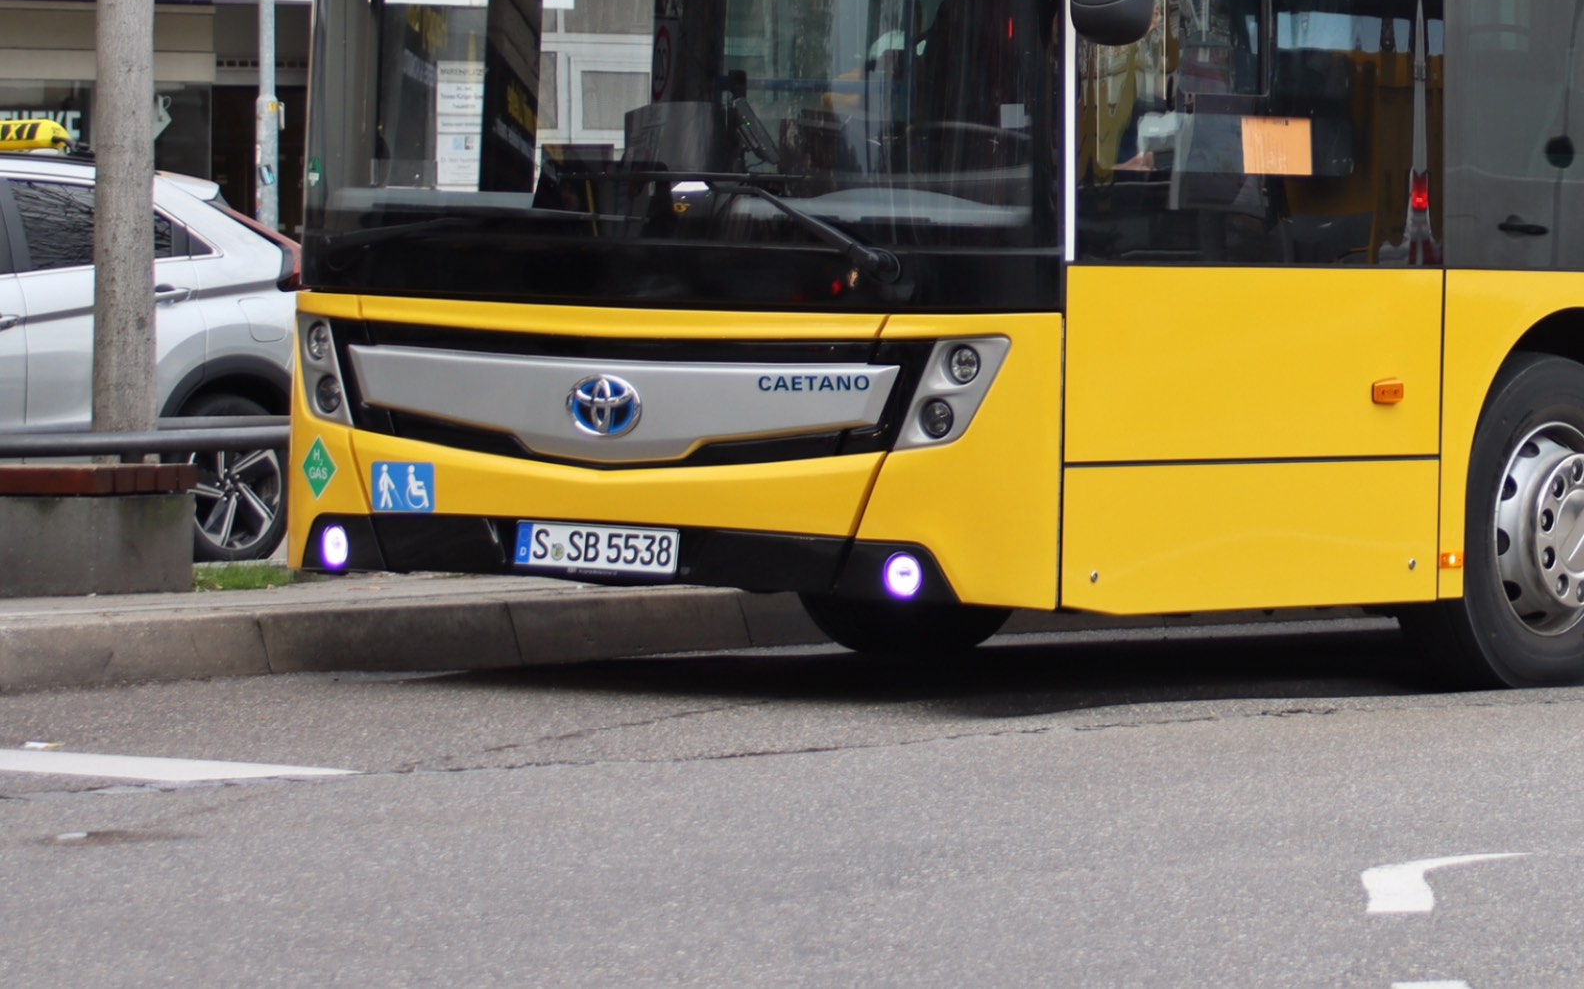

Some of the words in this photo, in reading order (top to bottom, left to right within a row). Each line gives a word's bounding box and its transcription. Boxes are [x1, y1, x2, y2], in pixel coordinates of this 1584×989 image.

[758, 375, 870, 391] CAETANO
[309, 466, 328, 480] GAS
[532, 528, 550, 560] S
[567, 530, 600, 562] SB
[606, 532, 673, 567] 5538
